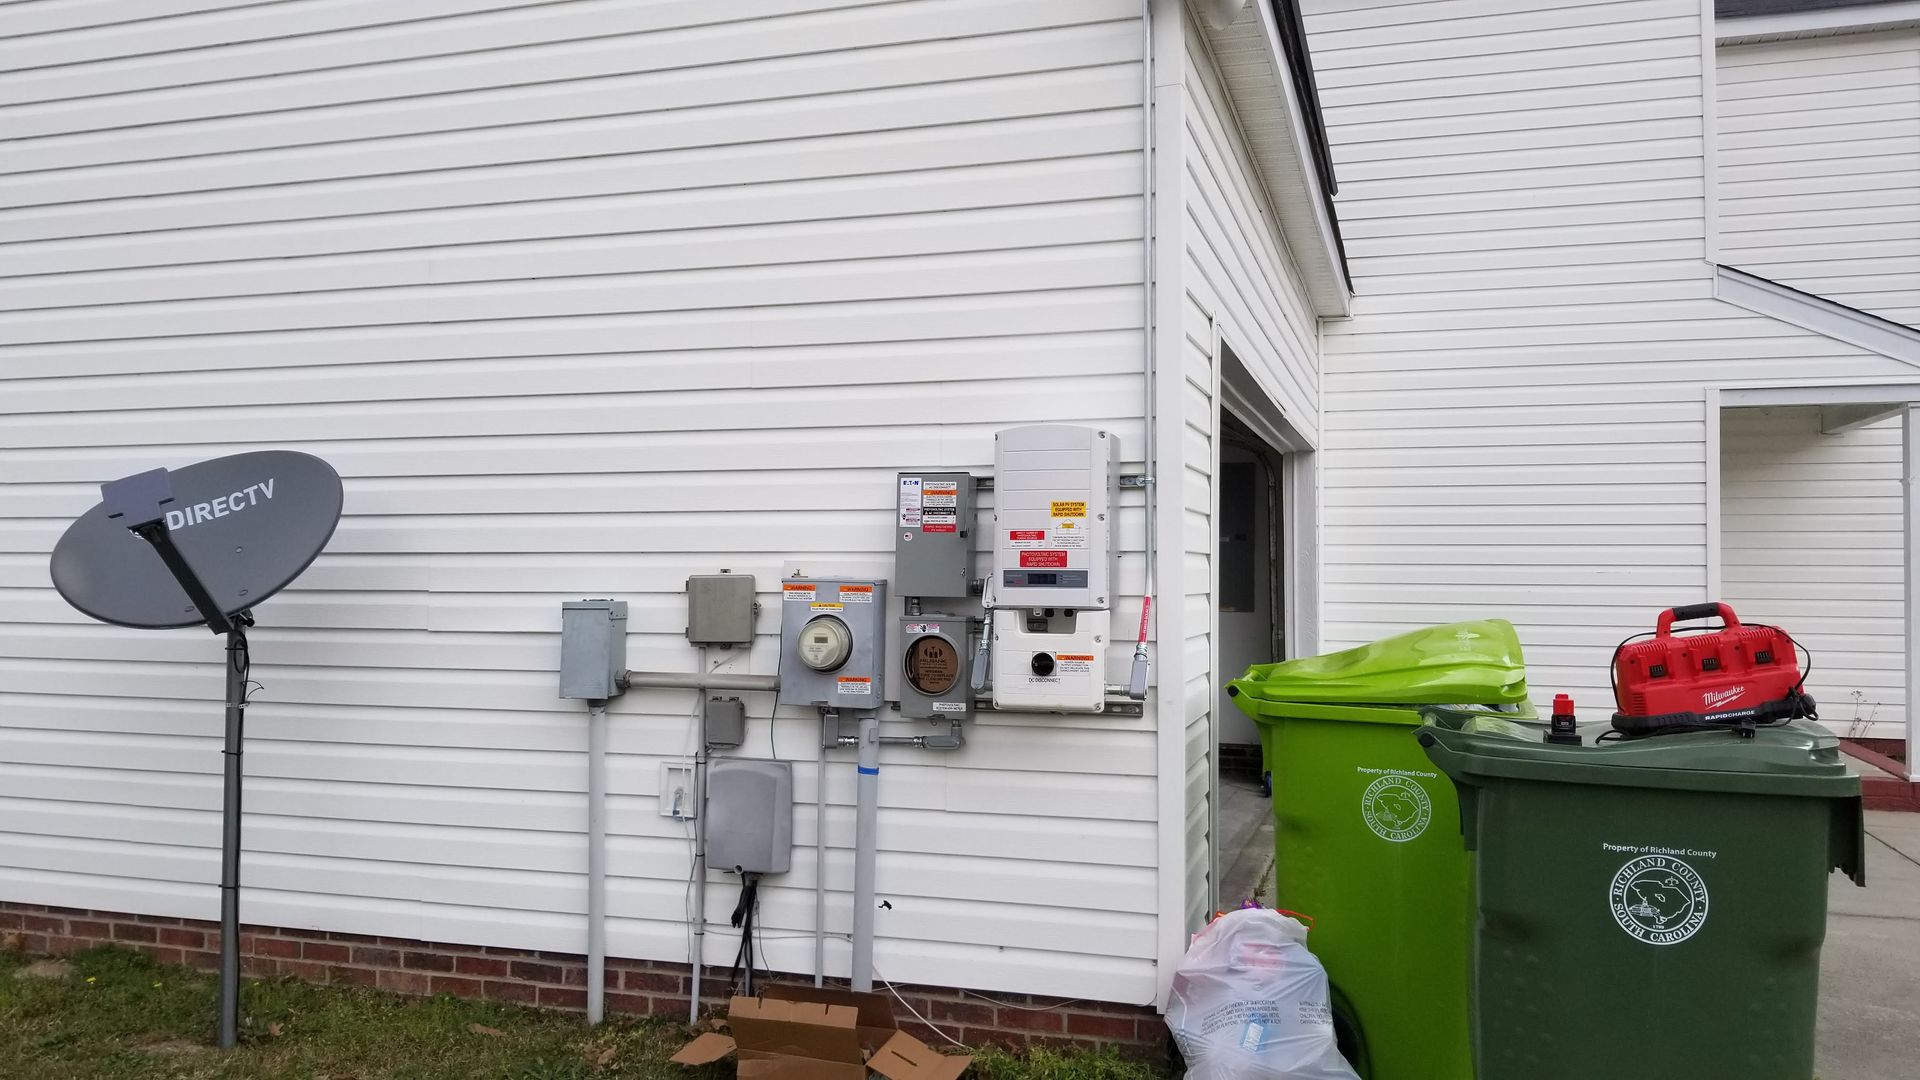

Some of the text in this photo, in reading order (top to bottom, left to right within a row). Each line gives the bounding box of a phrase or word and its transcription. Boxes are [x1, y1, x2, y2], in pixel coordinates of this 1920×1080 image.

[165, 478, 274, 531] DIRECTV
[1702, 685, 1745, 706] Milwaukee
[1357, 766, 1382, 775] Property
[1416, 771, 1437, 779] County
[1364, 777, 1429, 811] RICHLAND COUNTY
[1365, 810, 1428, 840] SOUTH CAROLINA
[1602, 843, 1638, 853] Property
[1650, 846, 1685, 855] Richland
[1687, 848, 1717, 859] County
[1613, 858, 1706, 903] RICHLAND COUNTY
[1614, 903, 1704, 942] SOUTH CAROLINA
